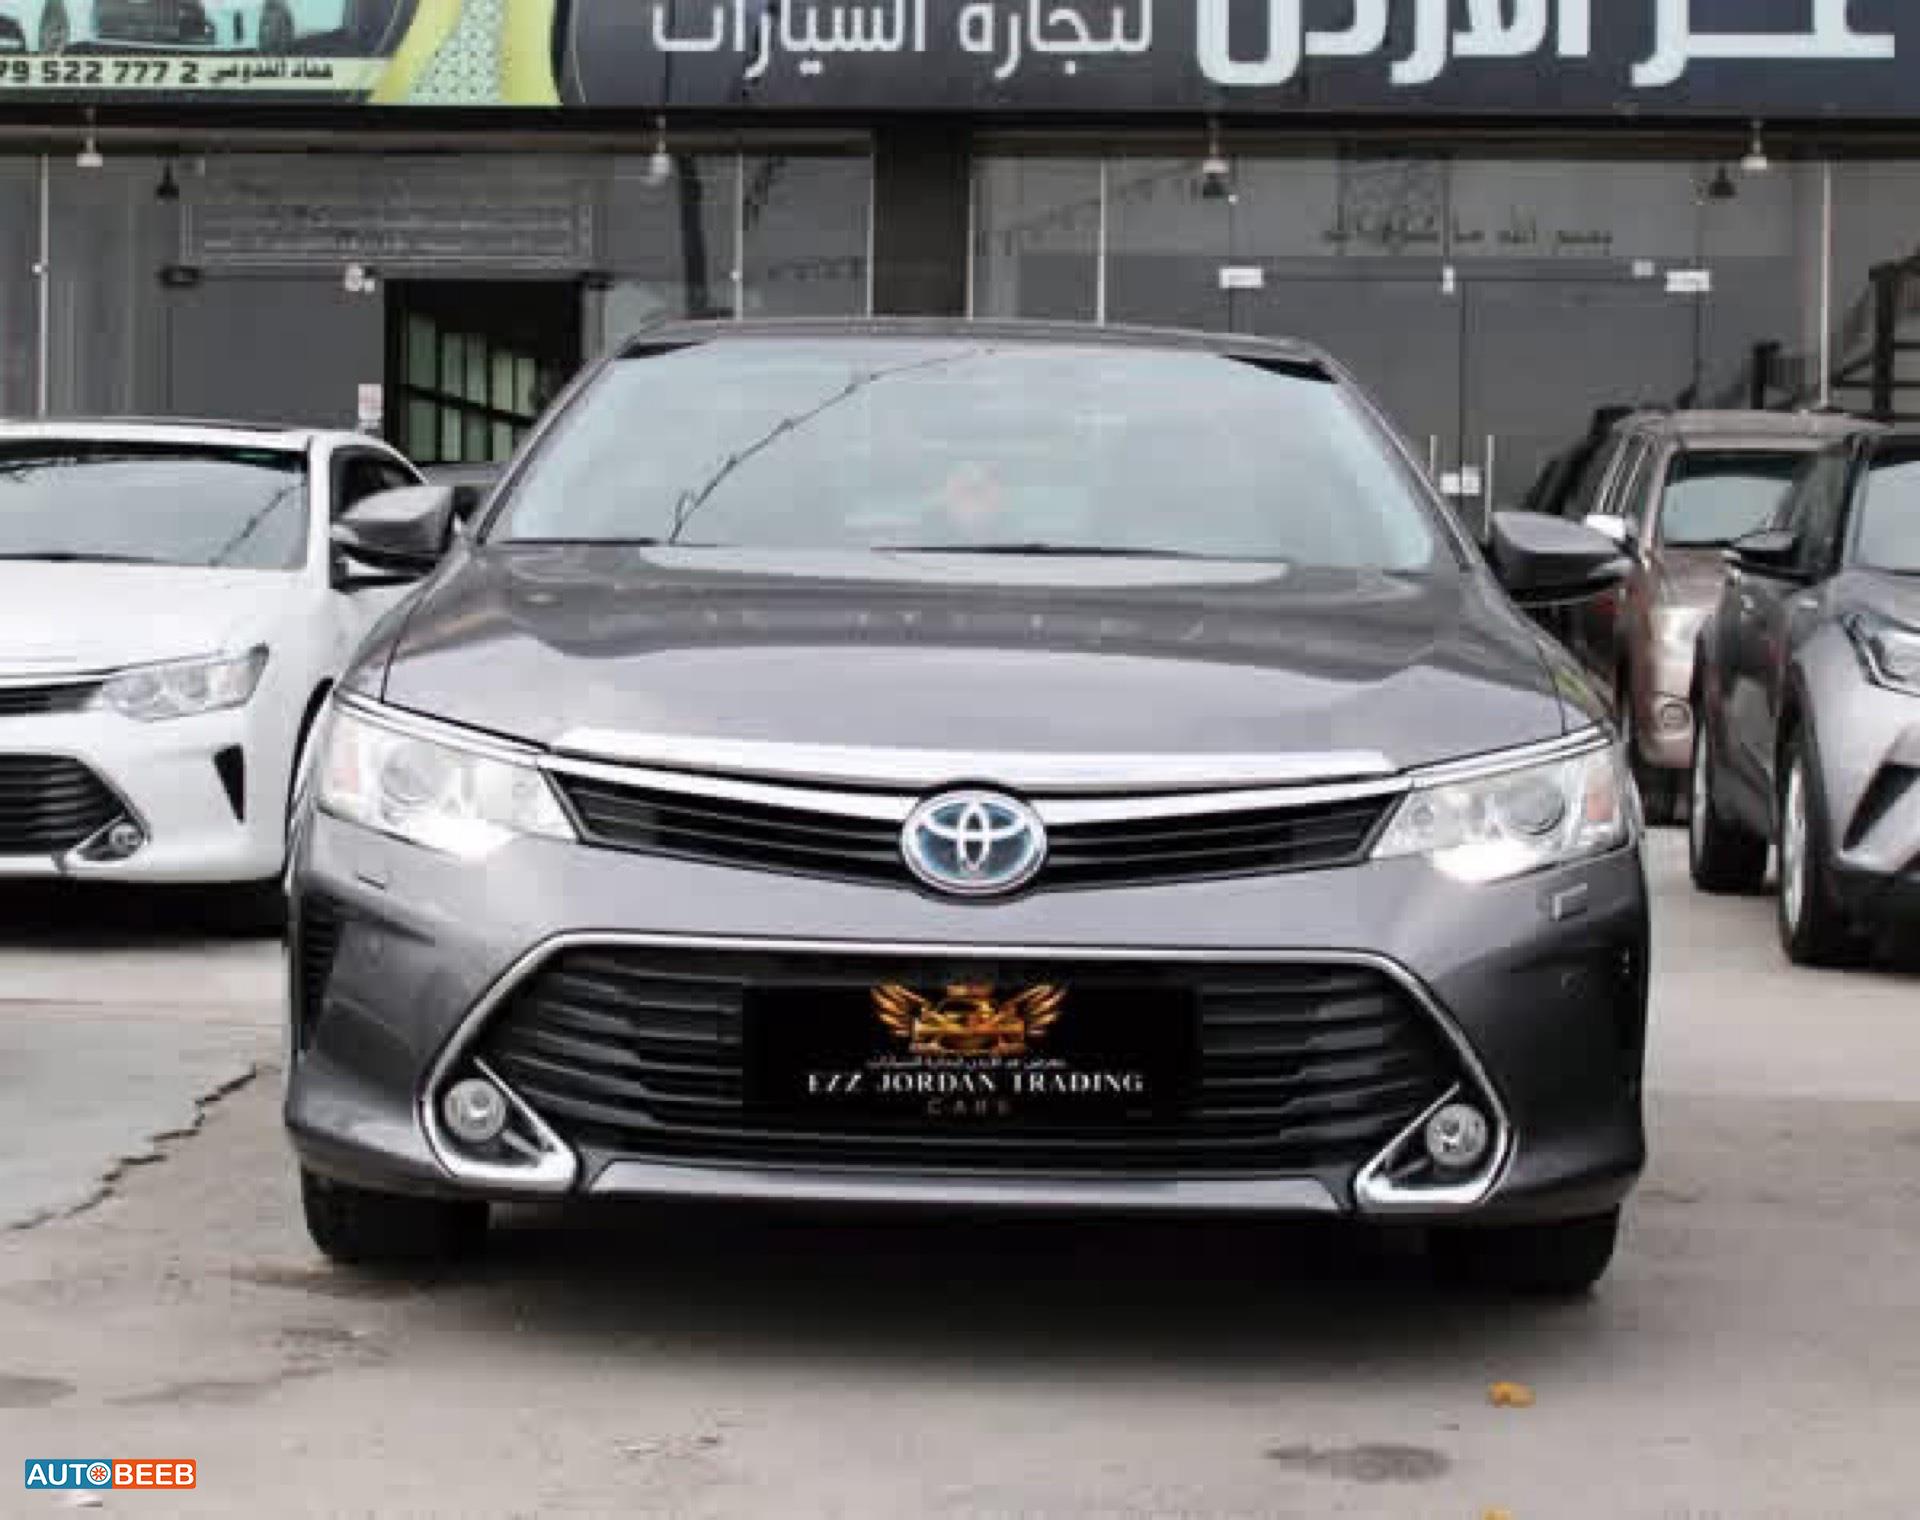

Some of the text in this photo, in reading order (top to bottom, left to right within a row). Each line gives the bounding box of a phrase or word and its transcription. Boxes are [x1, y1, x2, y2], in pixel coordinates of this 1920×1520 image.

[41, 60, 102, 83] 522
[112, 60, 168, 83] 777
[179, 60, 200, 83] 2
